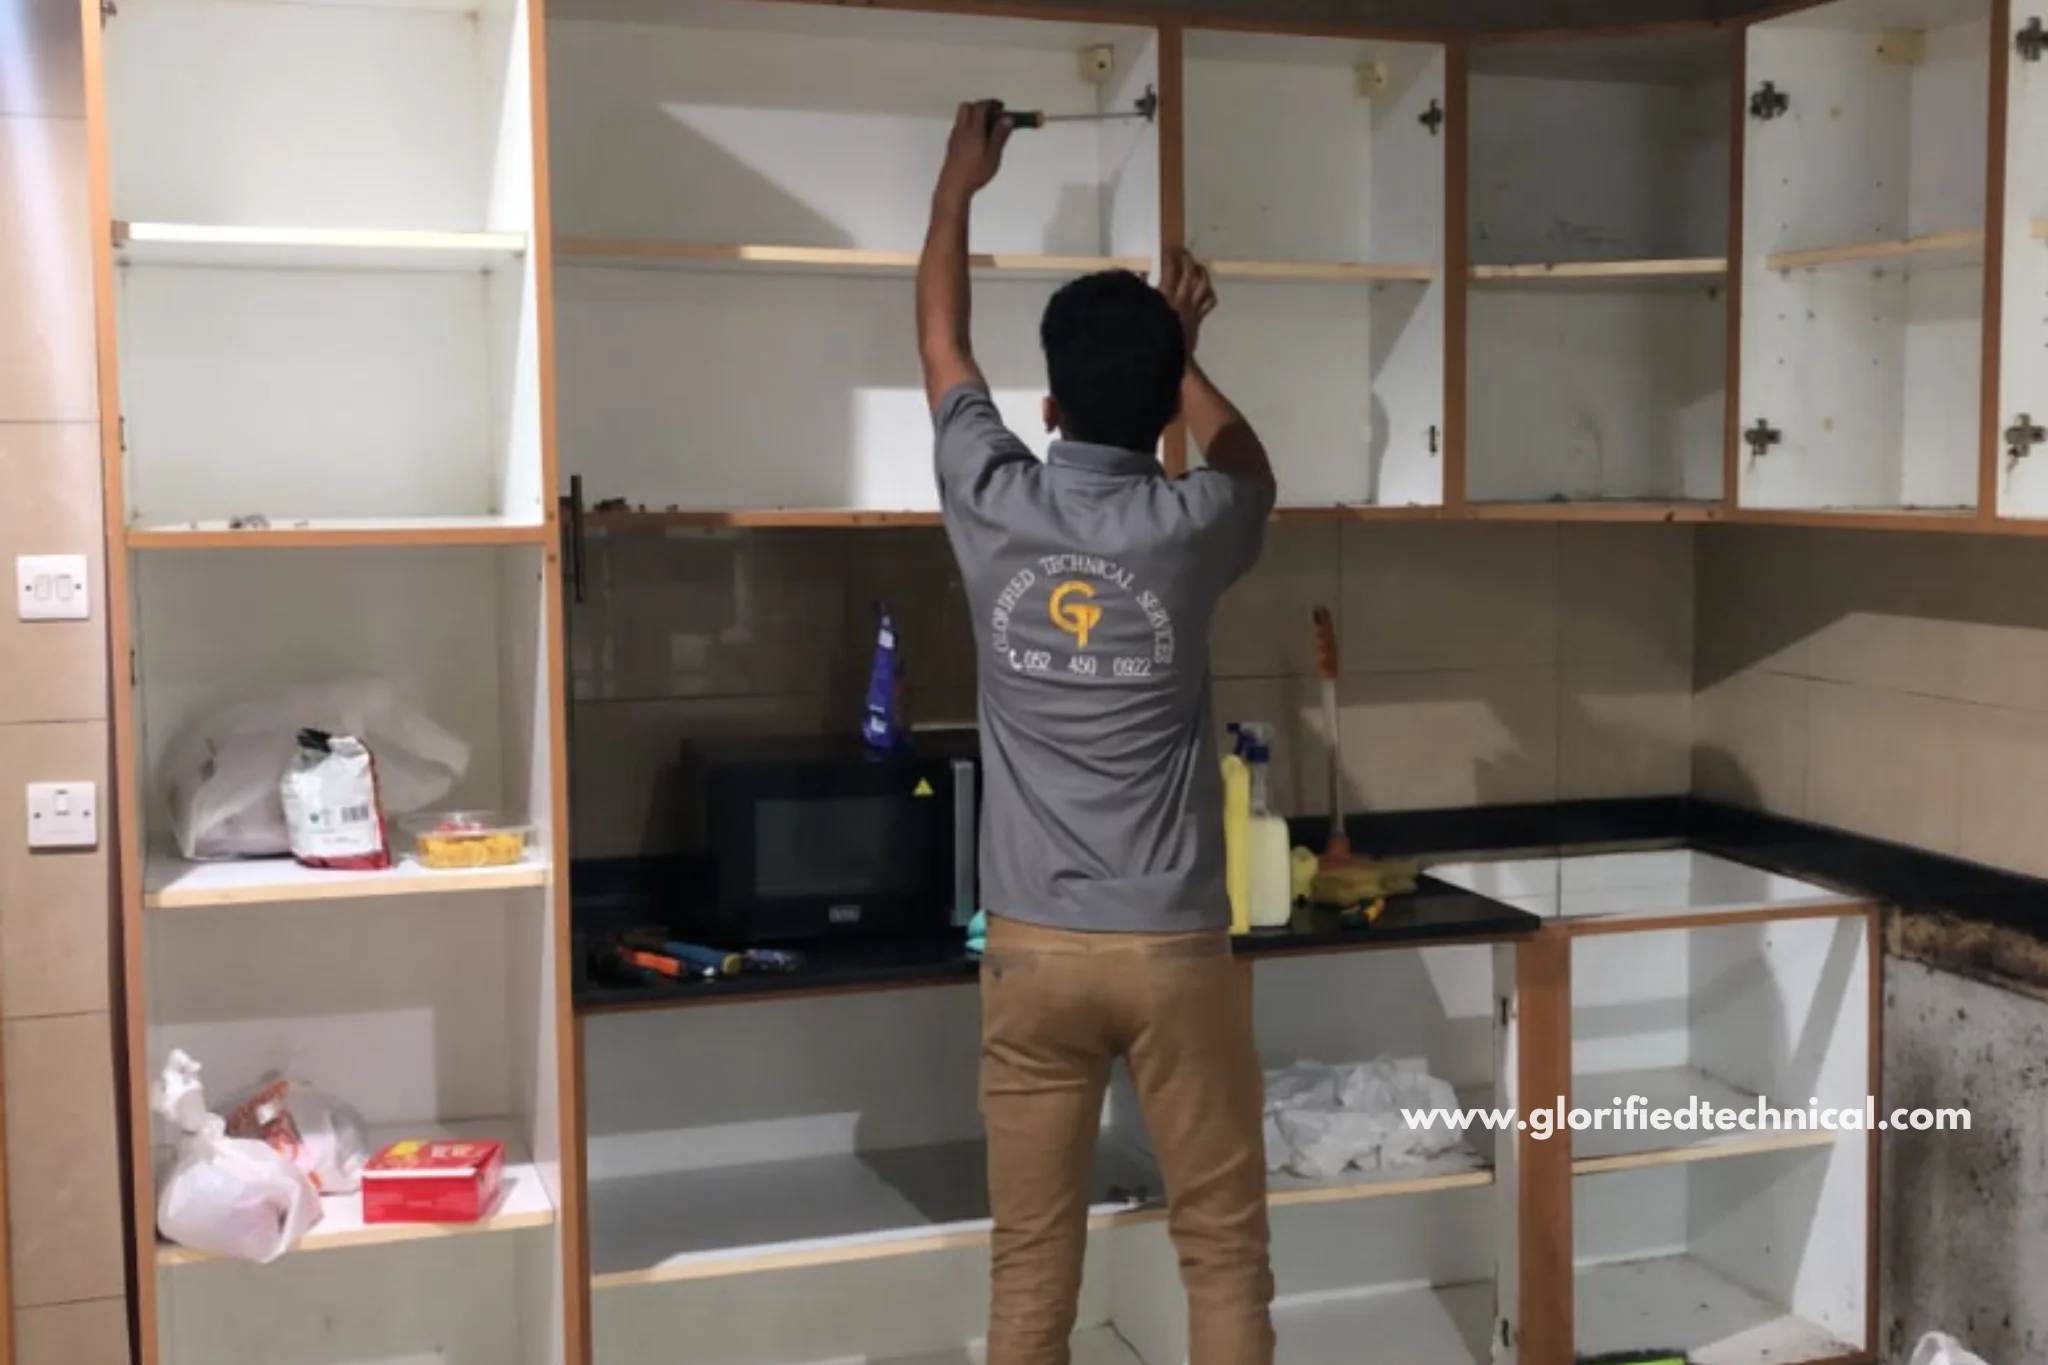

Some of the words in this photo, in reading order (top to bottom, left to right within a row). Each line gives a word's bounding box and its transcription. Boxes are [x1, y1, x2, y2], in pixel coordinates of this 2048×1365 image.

[1038, 554, 1135, 590] TECHNICAL
[1135, 589, 1175, 664] SERVICES
[1068, 656, 1097, 676] 450
[1113, 657, 1151, 676] 0922
